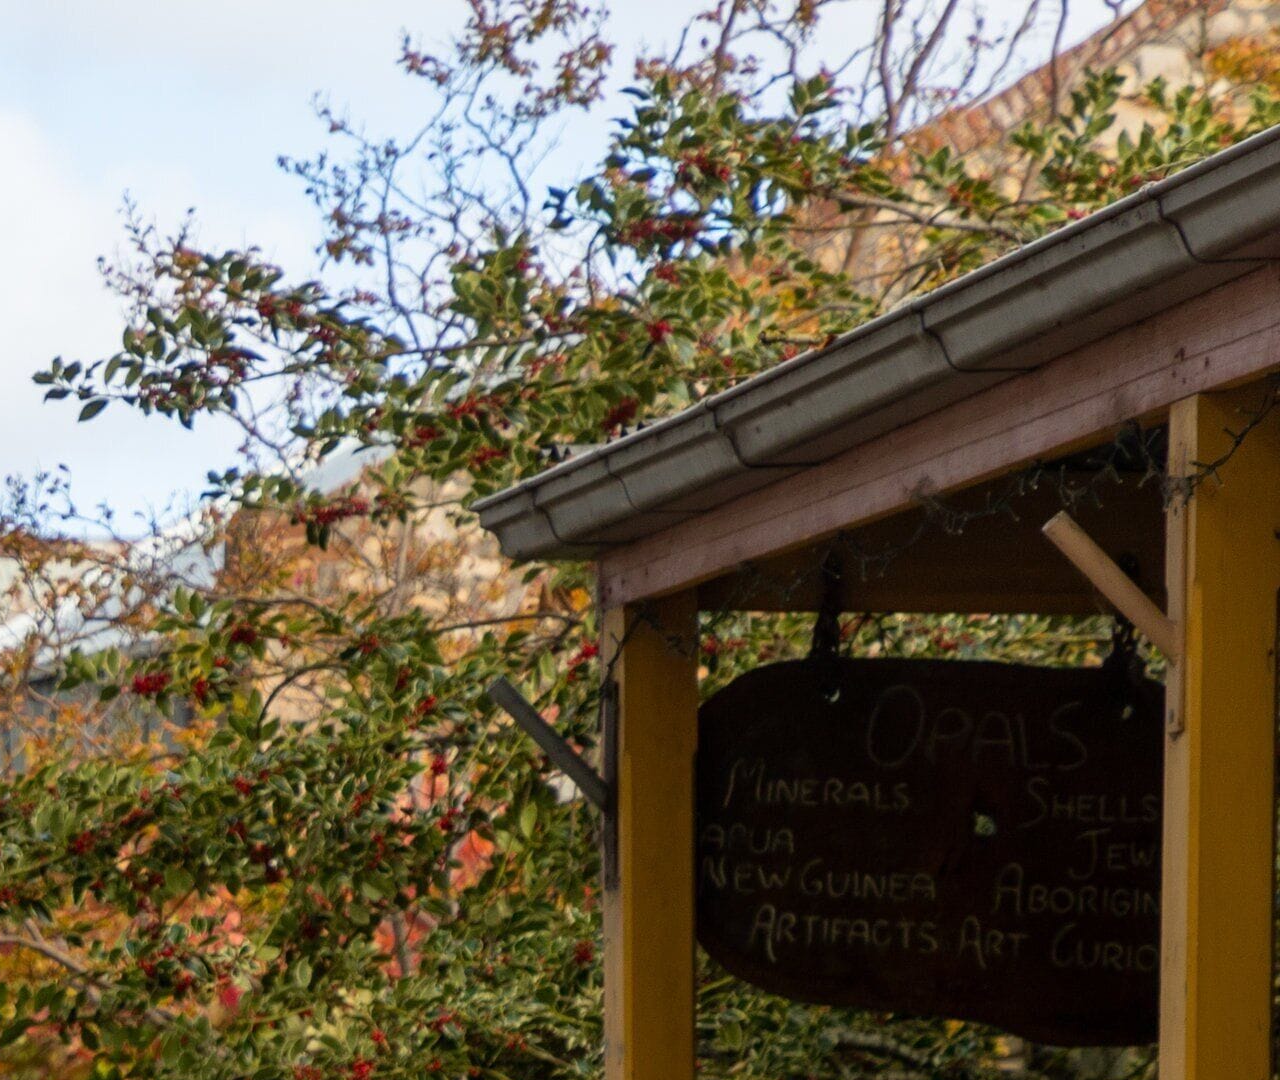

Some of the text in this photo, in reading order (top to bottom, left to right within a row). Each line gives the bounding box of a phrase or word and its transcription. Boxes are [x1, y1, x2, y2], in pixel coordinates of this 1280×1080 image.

[867, 684, 1088, 770] OPALS
[724, 758, 911, 812] MINERALS
[1020, 776, 1159, 830] SHELLS
[700, 822, 796, 855] APUA
[1069, 828, 1158, 881] JEW
[701, 856, 937, 902] NEW GUINEA
[993, 863, 1159, 918] ABORIGIN
[752, 904, 1159, 972] ARTIFACTS ART CURIO
